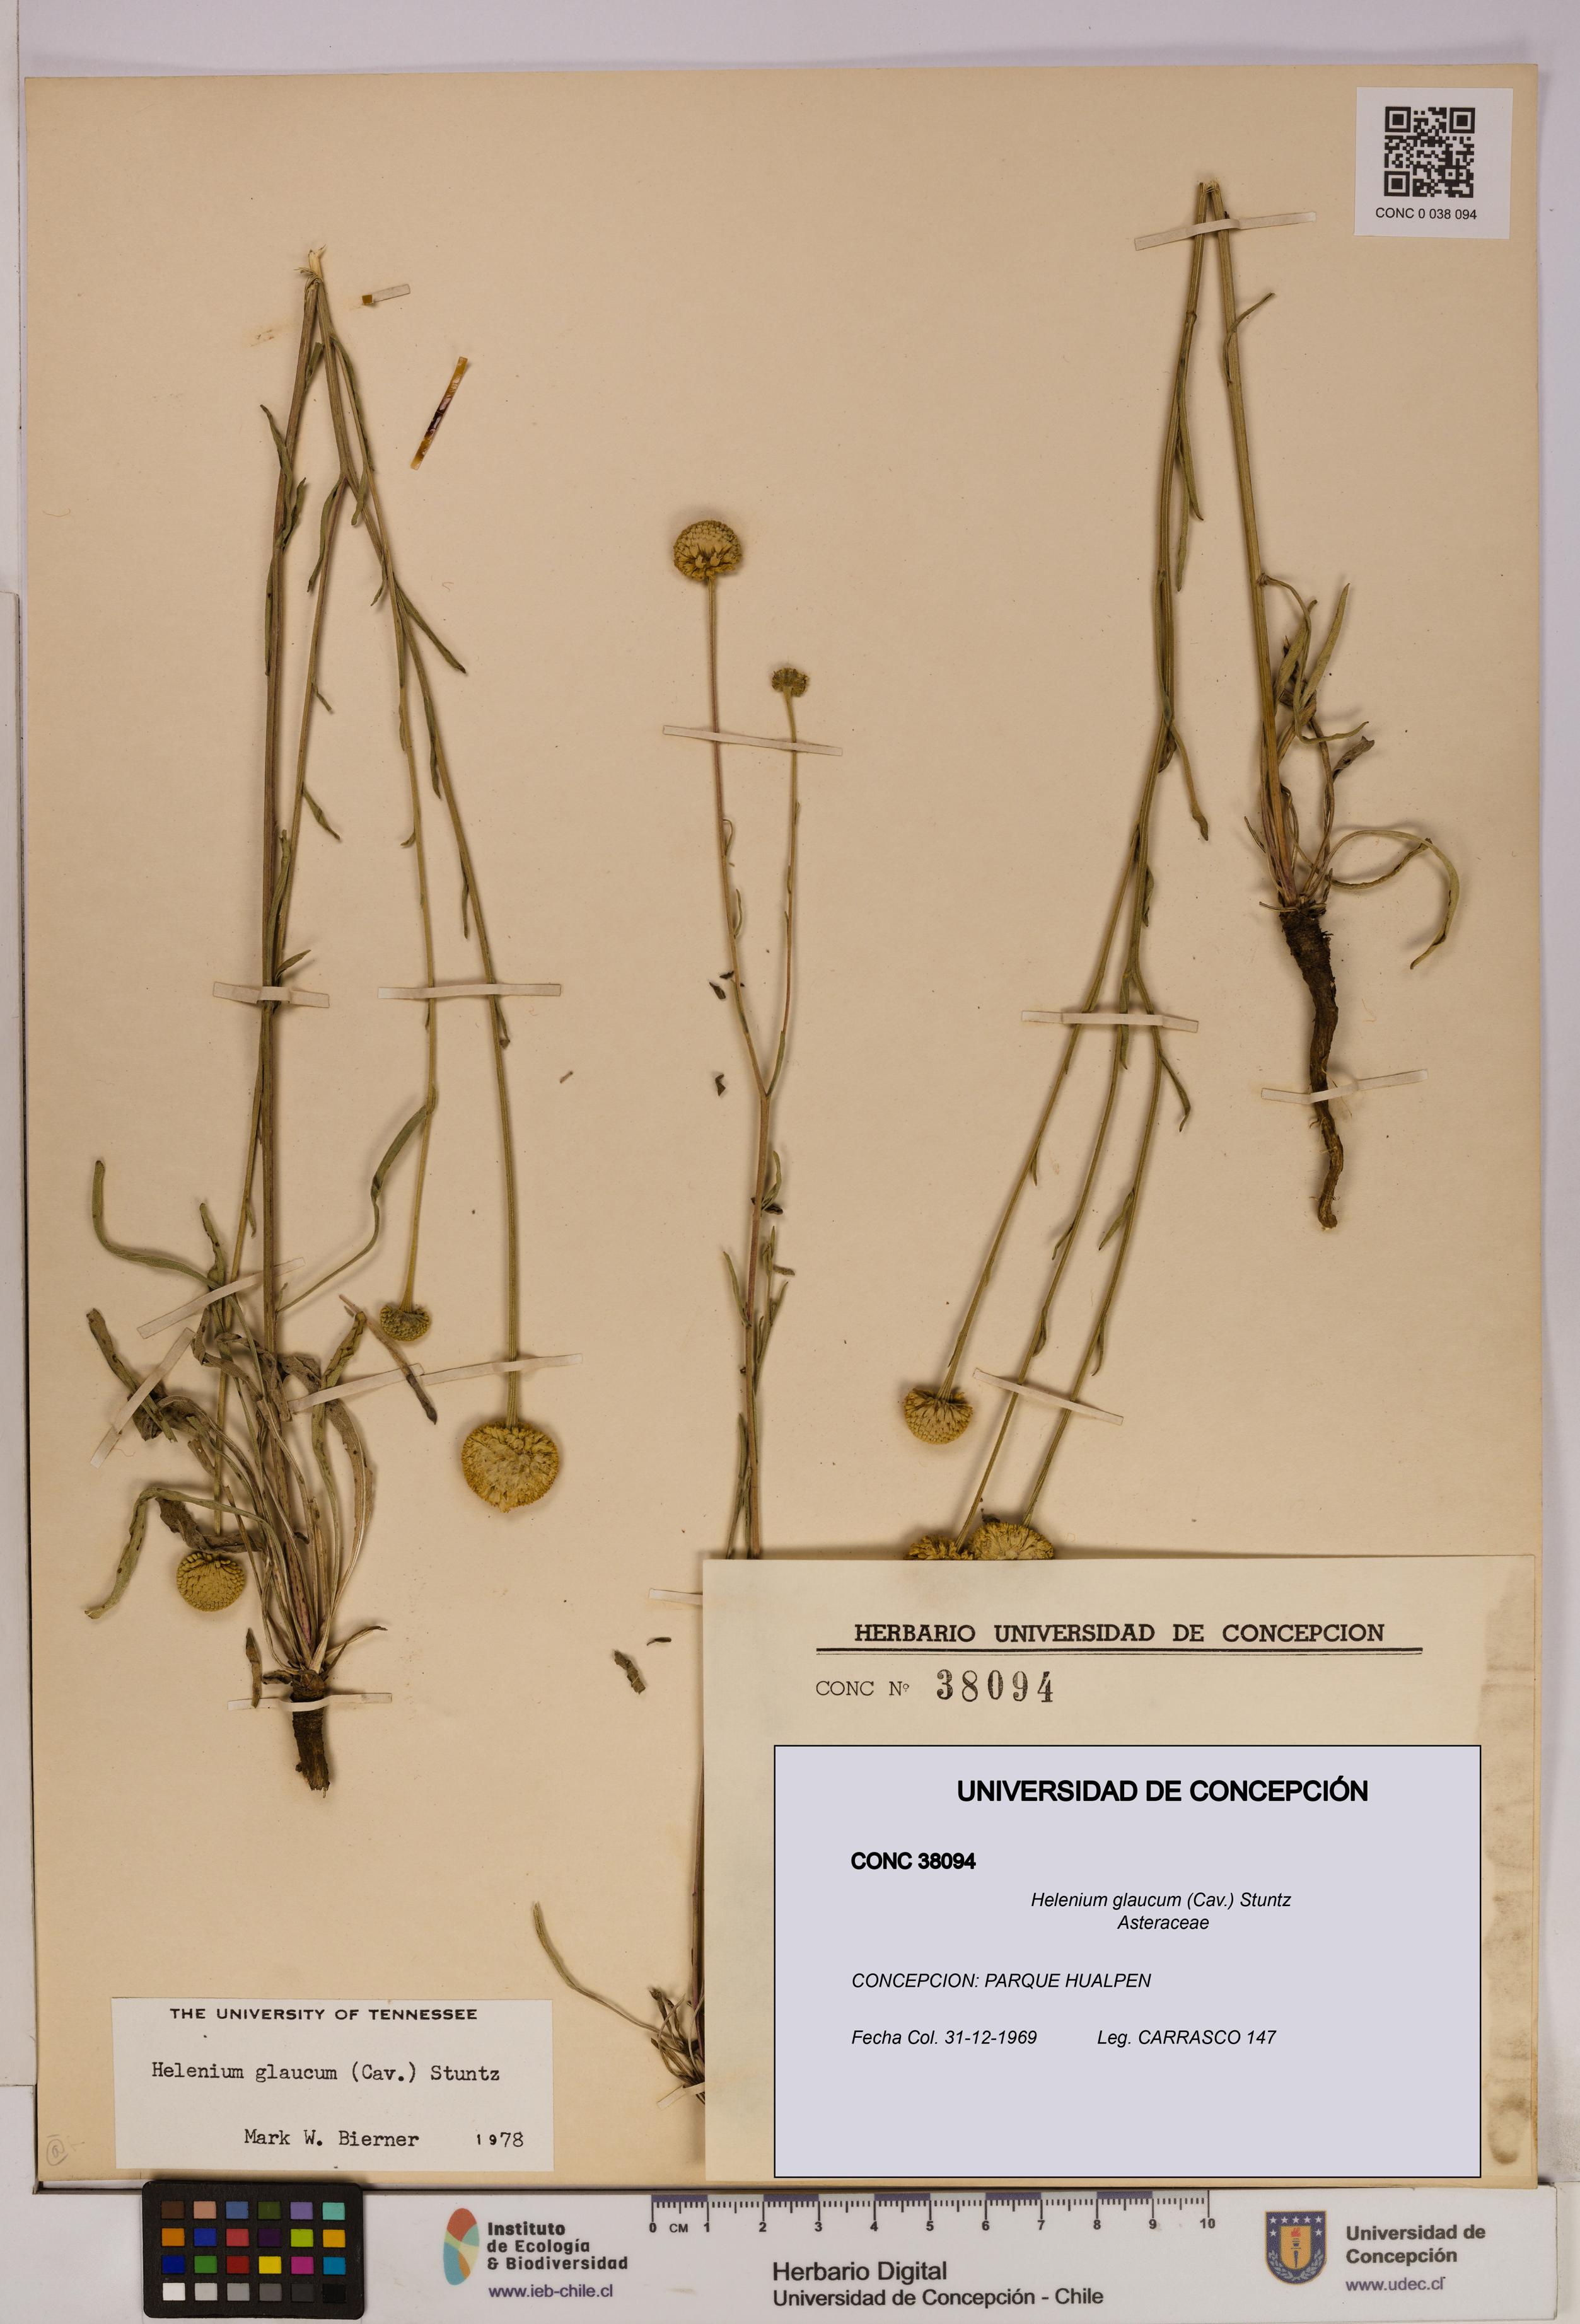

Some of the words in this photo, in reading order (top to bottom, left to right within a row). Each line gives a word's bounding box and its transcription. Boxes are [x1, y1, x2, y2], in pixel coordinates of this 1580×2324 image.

[1376, 207, 1415, 219] CONC
[1418, 208, 1426, 219] 0
[1429, 208, 1451, 219] 038
[1455, 209, 1477, 220] 094
[854, 1624, 976, 1643] HERBARIO
[994, 1623, 1156, 1643] UNIVERSIDAD
[1172, 1623, 1204, 1642] DE
[1222, 1623, 1385, 1643] CONCEPCION
[816, 1680, 874, 1696] CONC
[936, 1668, 1054, 1703] 38094
[170, 2008, 206, 2020] THE
[216, 2008, 325, 2020] UNIVERSITY
[335, 2009, 359, 2020] OF
[368, 2009, 477, 2021] TENNESSEE
[151, 2061, 245, 2079] Helenium
[255, 2064, 338, 2083] glaucum
[352, 2061, 416, 2083] (Cav.)
[431, 2065, 500, 2081] Stuntz
[244, 2129, 291, 2145] Mark
[303, 2129, 323, 2147] W.
[338, 2130, 420, 2147] Bierner
[477, 2131, 524, 2148] 1978
[487, 2221, 566, 2236] Instituto
[649, 2222, 657, 2233] 0
[669, 2223, 688, 2233] CM
[703, 2222, 710, 2233] 1
[758, 2221, 767, 2233] 2
[814, 2221, 823, 2233] 3
[869, 2221, 879, 2232] 4
[926, 2221, 934, 2232] 5
[981, 2220, 990, 2231] 6
[1037, 2220, 1045, 2231] 7
[1093, 2219, 1101, 2230] 8
[1148, 2219, 1157, 2229] 9
[1200, 2218, 1216, 2229] 10
[1346, 2224, 1458, 2241] Universidad
[1463, 2224, 1486, 2240] de
[487, 2239, 508, 2253] de
[514, 2238, 590, 2255] Ecología
[487, 2257, 499, 2270] &
[506, 2255, 628, 2270] Biodiversidad
[1345, 2247, 1458, 2266] Concepción
[773, 2261, 870, 2281] Herbario
[878, 2260, 947, 2285] Digital
[488, 2284, 613, 2298] www.ieb-chile.cl
[1345, 2276, 1444, 2291] www.udec.cl
[774, 2289, 886, 2306] Universidad
[892, 2289, 916, 2306] de
[922, 2288, 1035, 2310] Concepción
[1055, 2287, 1104, 2305] Chile
